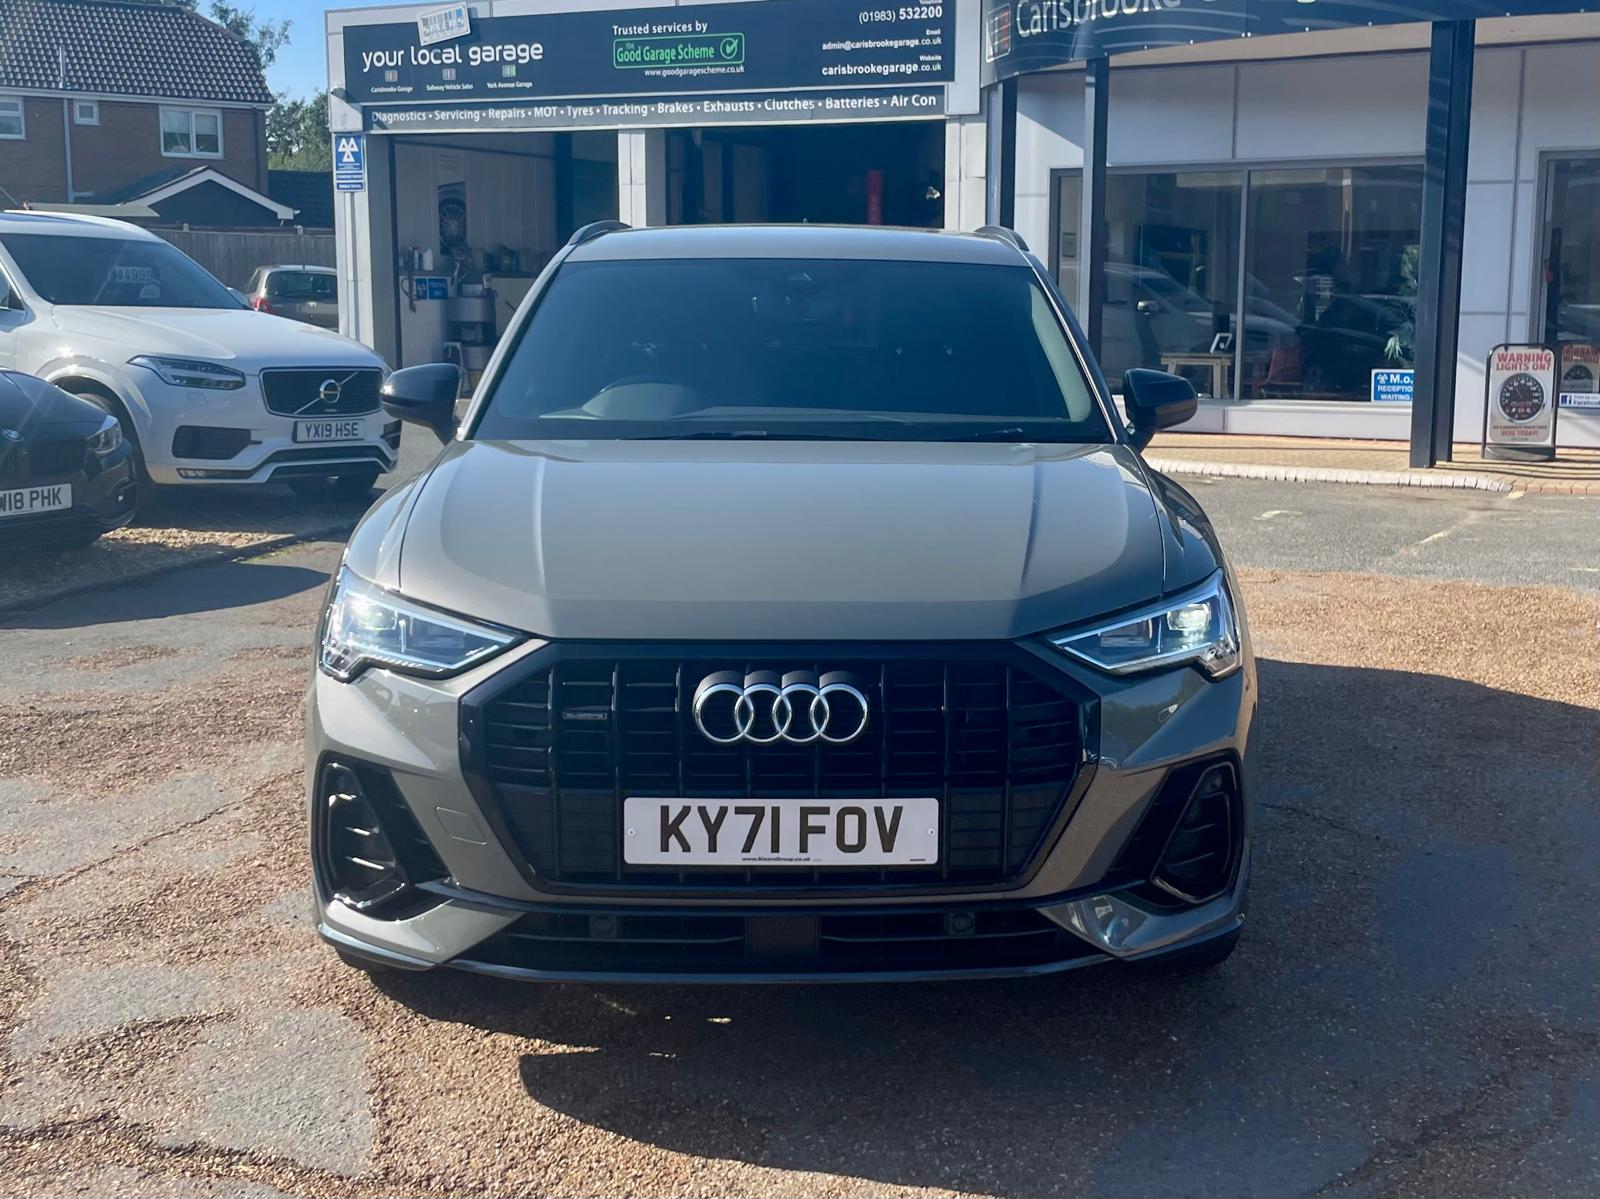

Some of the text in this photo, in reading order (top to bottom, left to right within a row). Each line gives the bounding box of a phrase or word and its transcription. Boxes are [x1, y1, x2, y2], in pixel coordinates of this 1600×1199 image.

[859, 6, 943, 24] (01983) 532200
[612, 20, 708, 36] Trusted services by
[822, 37, 942, 51] admin@carisbrookegarage.co.uk
[362, 43, 544, 72] your local garage
[616, 43, 715, 64] Good Garage Scheme
[644, 64, 745, 77] www.goodgaragescheme.co.uk
[822, 63, 942, 76] carisbrookegarage.co.uk
[371, 94, 937, 125] Diagnostics Servicing Repairs MOT Tyres Tracking Brakes Exhausts Clutches Batteries Air Con
[1497, 352, 1552, 363] WARNING
[1496, 362, 1551, 371] LIGHTS ON?
[305, 422, 359, 438] YX19 HSE
[29, 486, 62, 508] PHK
[659, 805, 904, 853] KY71 FOV
